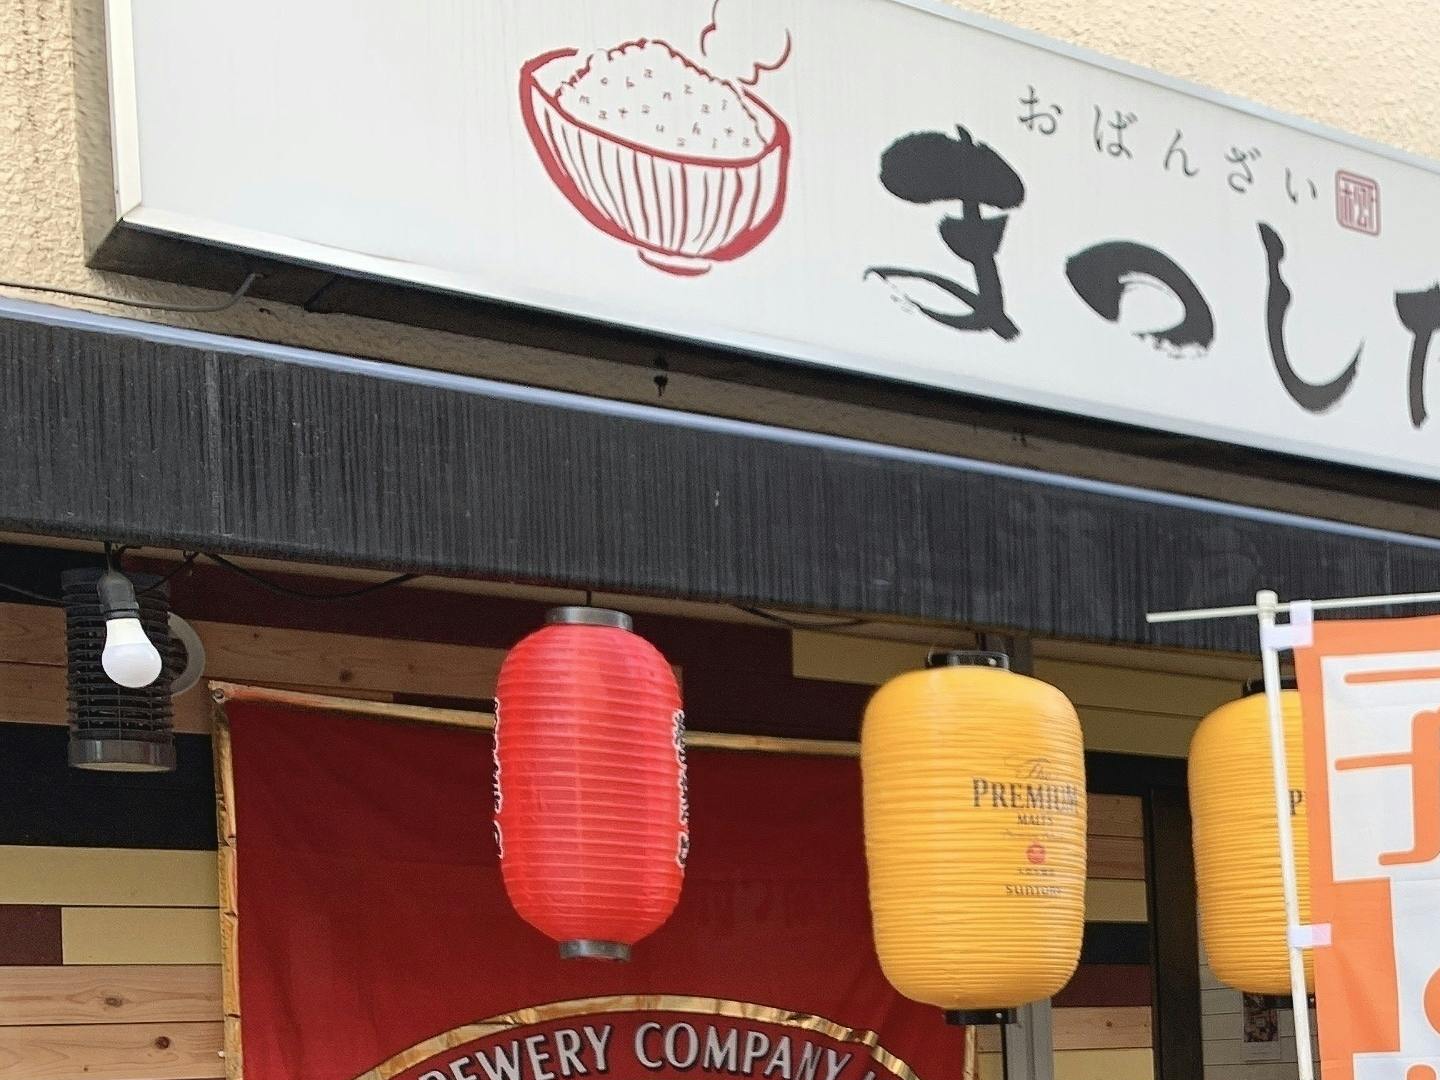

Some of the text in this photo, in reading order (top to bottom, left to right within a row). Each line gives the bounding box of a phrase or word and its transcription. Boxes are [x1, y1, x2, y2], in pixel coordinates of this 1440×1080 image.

[1018, 85, 1318, 204] おばんざい
